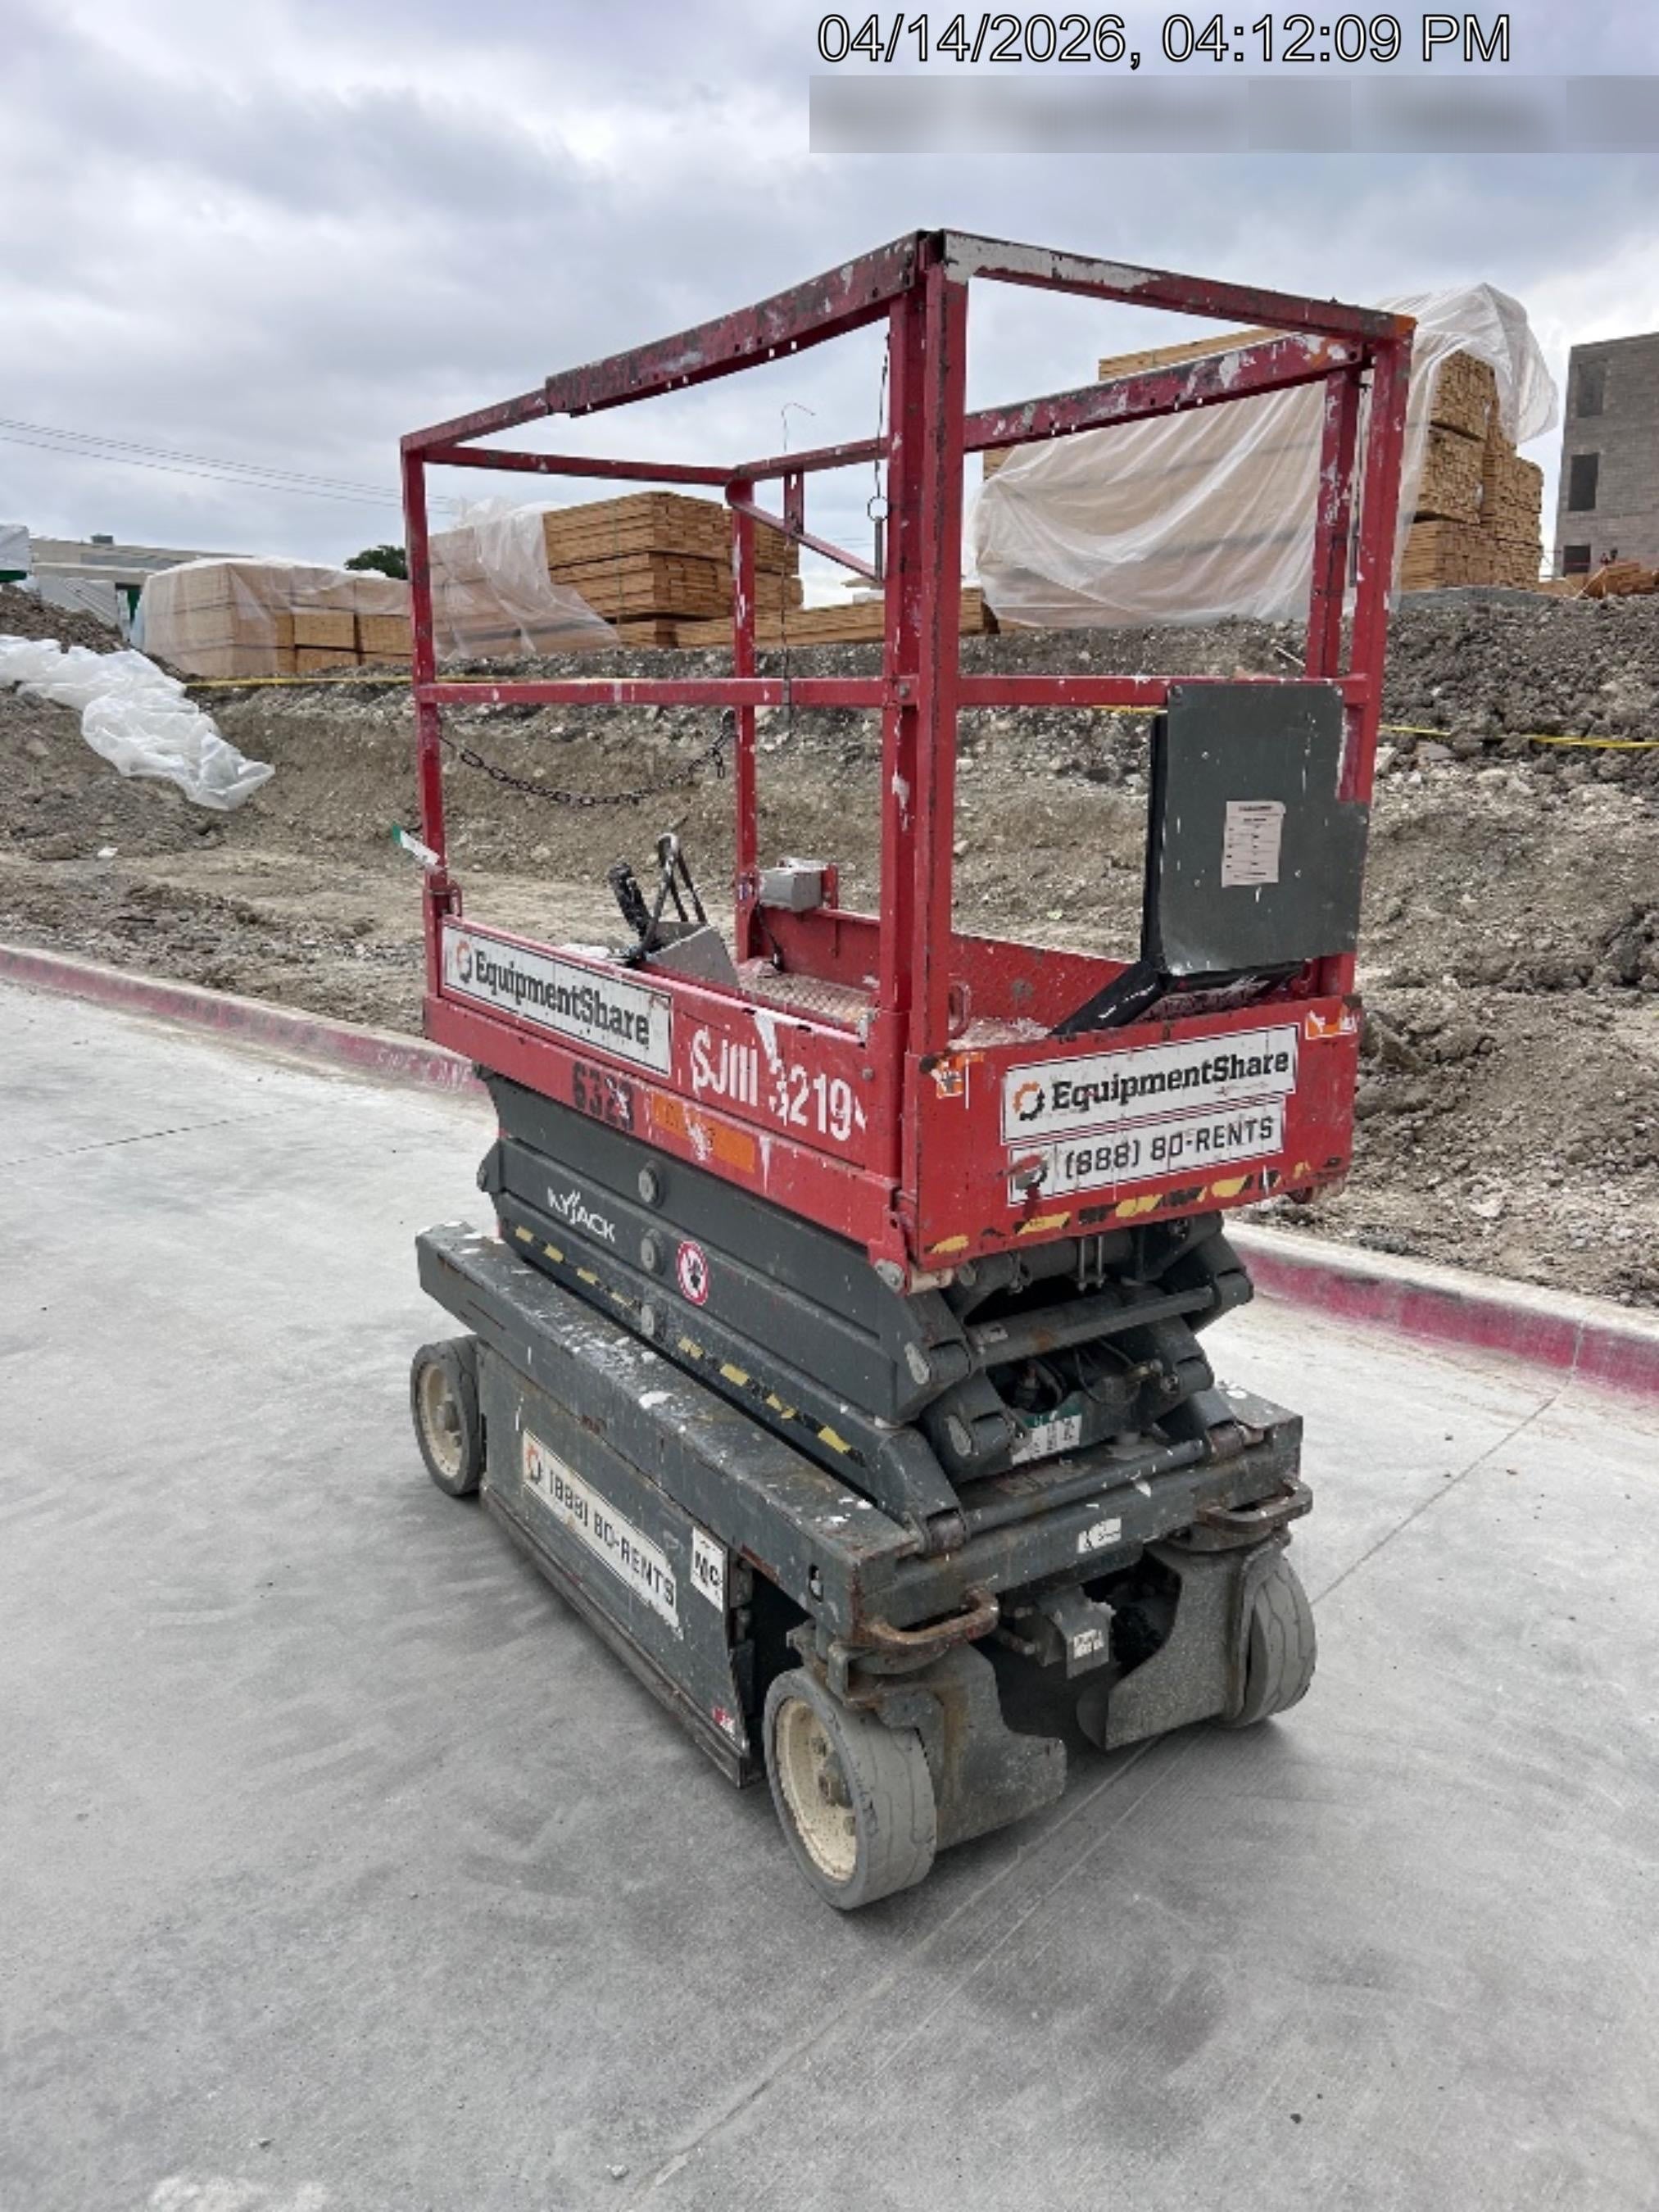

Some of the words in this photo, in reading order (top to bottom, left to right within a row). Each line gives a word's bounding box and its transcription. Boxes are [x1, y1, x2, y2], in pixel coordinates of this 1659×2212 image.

[475, 949, 650, 1047] EquipmentShare
[1051, 1049, 1290, 1113] EquipmentShare
[1065, 1140, 1140, 1179] (888)
[1151, 1115, 1275, 1162] 80-RENTS
